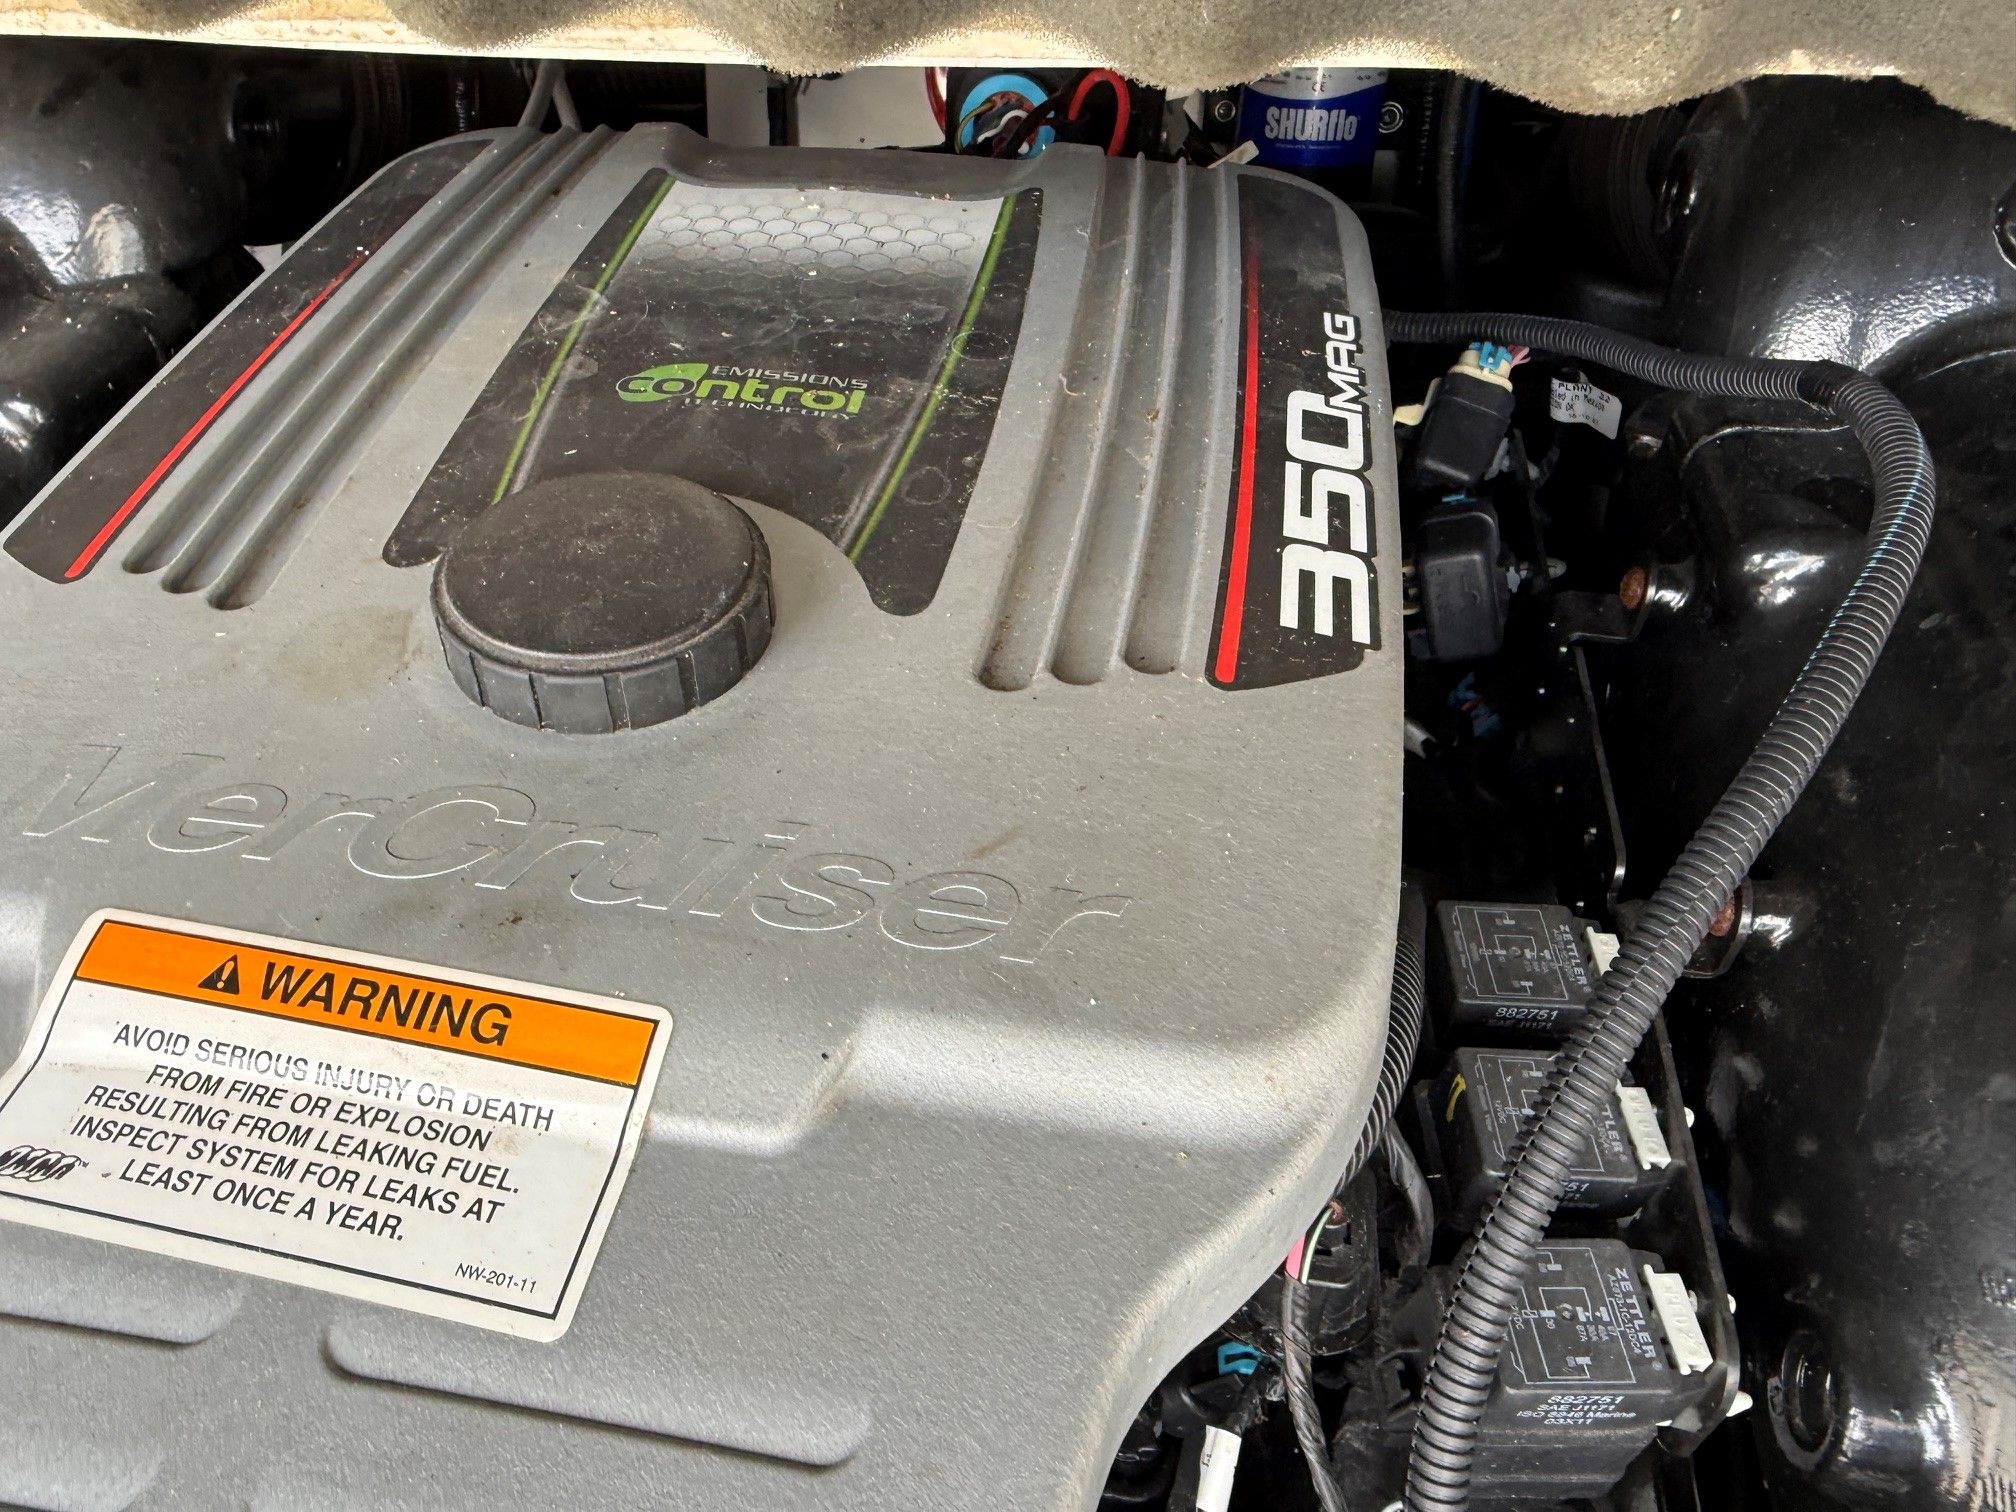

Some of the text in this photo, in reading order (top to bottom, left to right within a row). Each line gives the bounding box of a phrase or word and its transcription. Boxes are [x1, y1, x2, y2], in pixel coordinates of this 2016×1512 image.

[1264, 106, 1358, 141] SHURflo
[711, 365, 869, 389] EMISSIONS
[1280, 311, 1371, 645] 350 MAG
[1560, 924, 1587, 985] ZETTLER
[260, 961, 512, 1046] WARNING
[1495, 1007, 1559, 1020] 882751
[113, 1024, 554, 1132] AVOID SERIOUS INJURY OR DEATH
[146, 1064, 493, 1151] FROM FIRE OR EXPLOSION
[70, 1115, 505, 1224] INSPECT SYSTEM FOR LEAKS AT
[84, 1085, 519, 1193] RESULTING FROM LEAKING FUEL.
[119, 1158, 213, 1196] LEAST
[212, 1179, 295, 1215] ONCE
[294, 1197, 317, 1221] A
[325, 1201, 404, 1241] YEAR.
[455, 1263, 537, 1294] NW-201-11
[1615, 1267, 1656, 1358] ZETTLER
[1547, 1395, 1625, 1404] 882751
